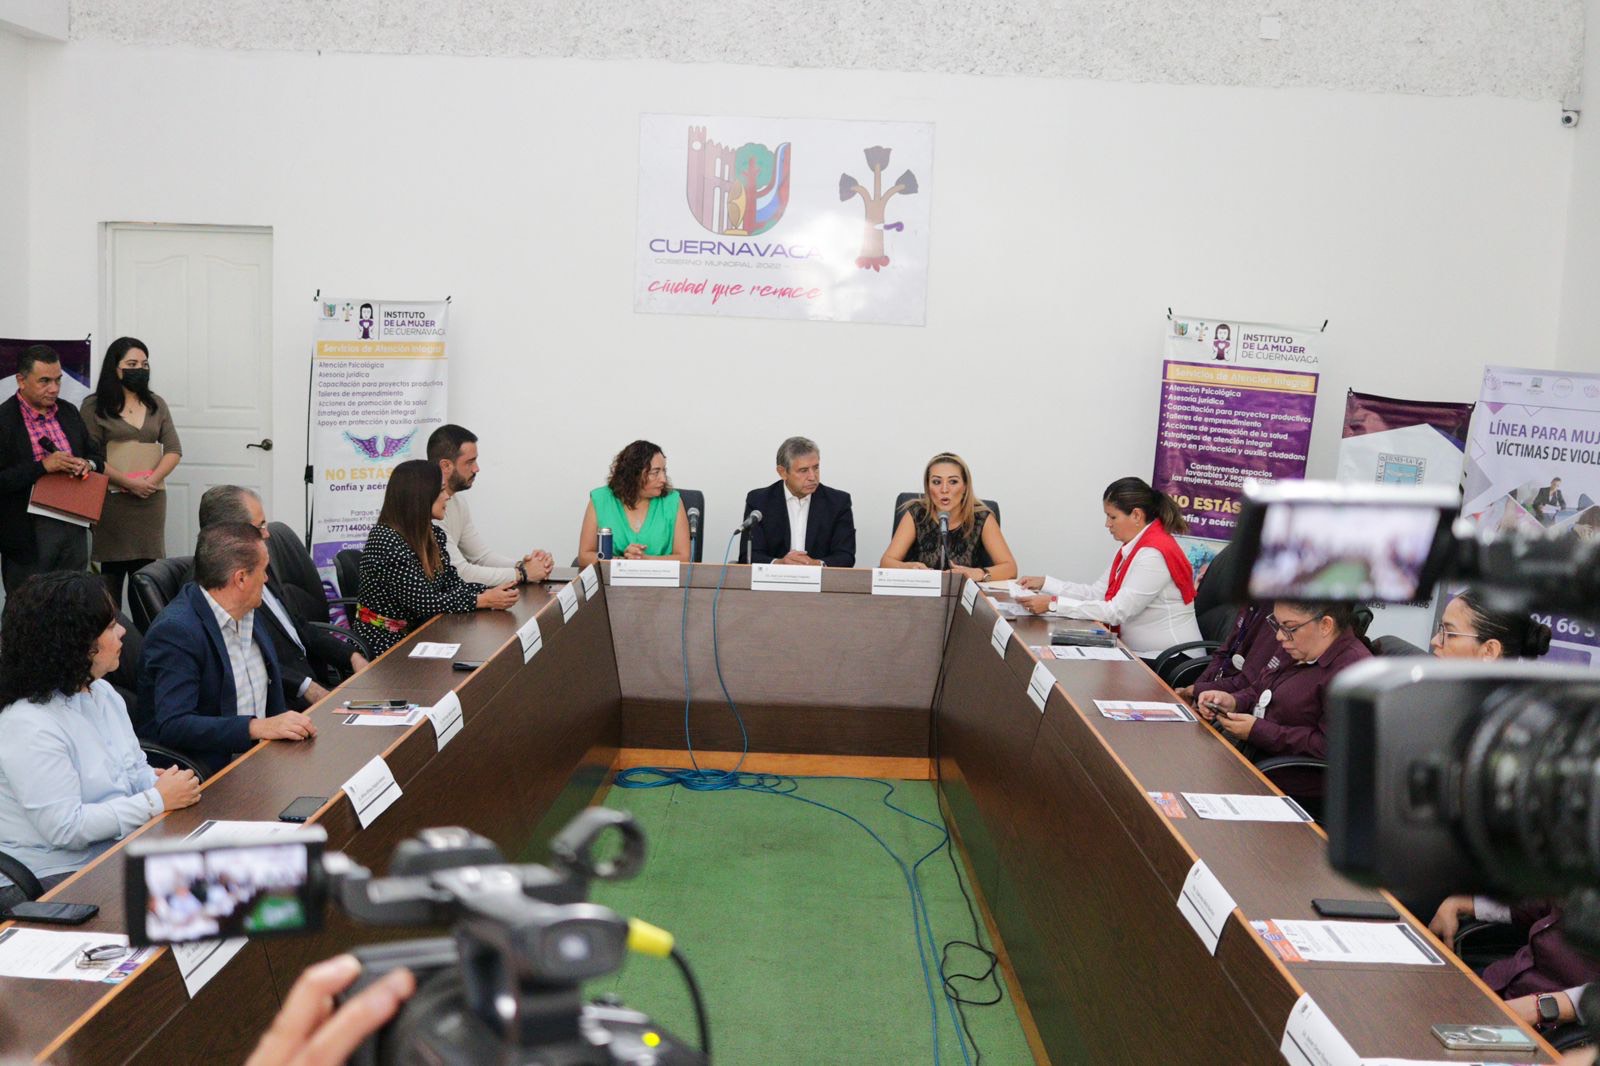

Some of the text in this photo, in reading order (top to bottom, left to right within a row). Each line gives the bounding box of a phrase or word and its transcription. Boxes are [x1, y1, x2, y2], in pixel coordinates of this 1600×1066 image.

[649, 239, 823, 259] CUERNAVACA
[648, 278, 824, 305] ciudad que renace
[384, 311, 425, 319] INSTITUTO
[1243, 333, 1293, 344] INSTITUTO
[1242, 342, 1255, 350] DE
[1271, 345, 1306, 354] MUJER
[1241, 351, 1319, 364] DE CUERNAVACA
[1216, 372, 1228, 380] de
[352, 390, 403, 398] emprendimiento
[1169, 384, 1241, 398] Atención Psicológica
[1168, 394, 1196, 403] Asesoría
[1167, 403, 1214, 414] Capacitación
[1234, 410, 1269, 420] proyectos
[1271, 413, 1311, 423] productivos
[348, 418, 383, 426] protección
[1166, 413, 1191, 421] Talleres
[1204, 415, 1262, 428] emprendimiento
[1165, 422, 1288, 440] Acciones de promoción de la salud
[1489, 420, 1600, 445] LÍNEA PARA MUJ
[1164, 431, 1273, 448] Estrategias de atención integral
[1163, 440, 1186, 450] Apoyo
[1198, 443, 1236, 454] protección
[1244, 447, 1267, 457] auxilio
[1268, 450, 1306, 461] ciudadano
[1496, 439, 1549, 460] VÍCTIMAS
[1552, 447, 1568, 462] DE
[325, 469, 345, 480] NO
[1186, 469, 1223, 480] favorables
[1190, 463, 1272, 478] Construyendo espacios
[330, 483, 357, 492] Confía
[1214, 479, 1243, 488] adolesc
[1193, 497, 1242, 514] ESTÁS
[1200, 517, 1207, 526] y
[1209, 516, 1238, 528] acérc
[1556, 618, 1580, 634] 66
